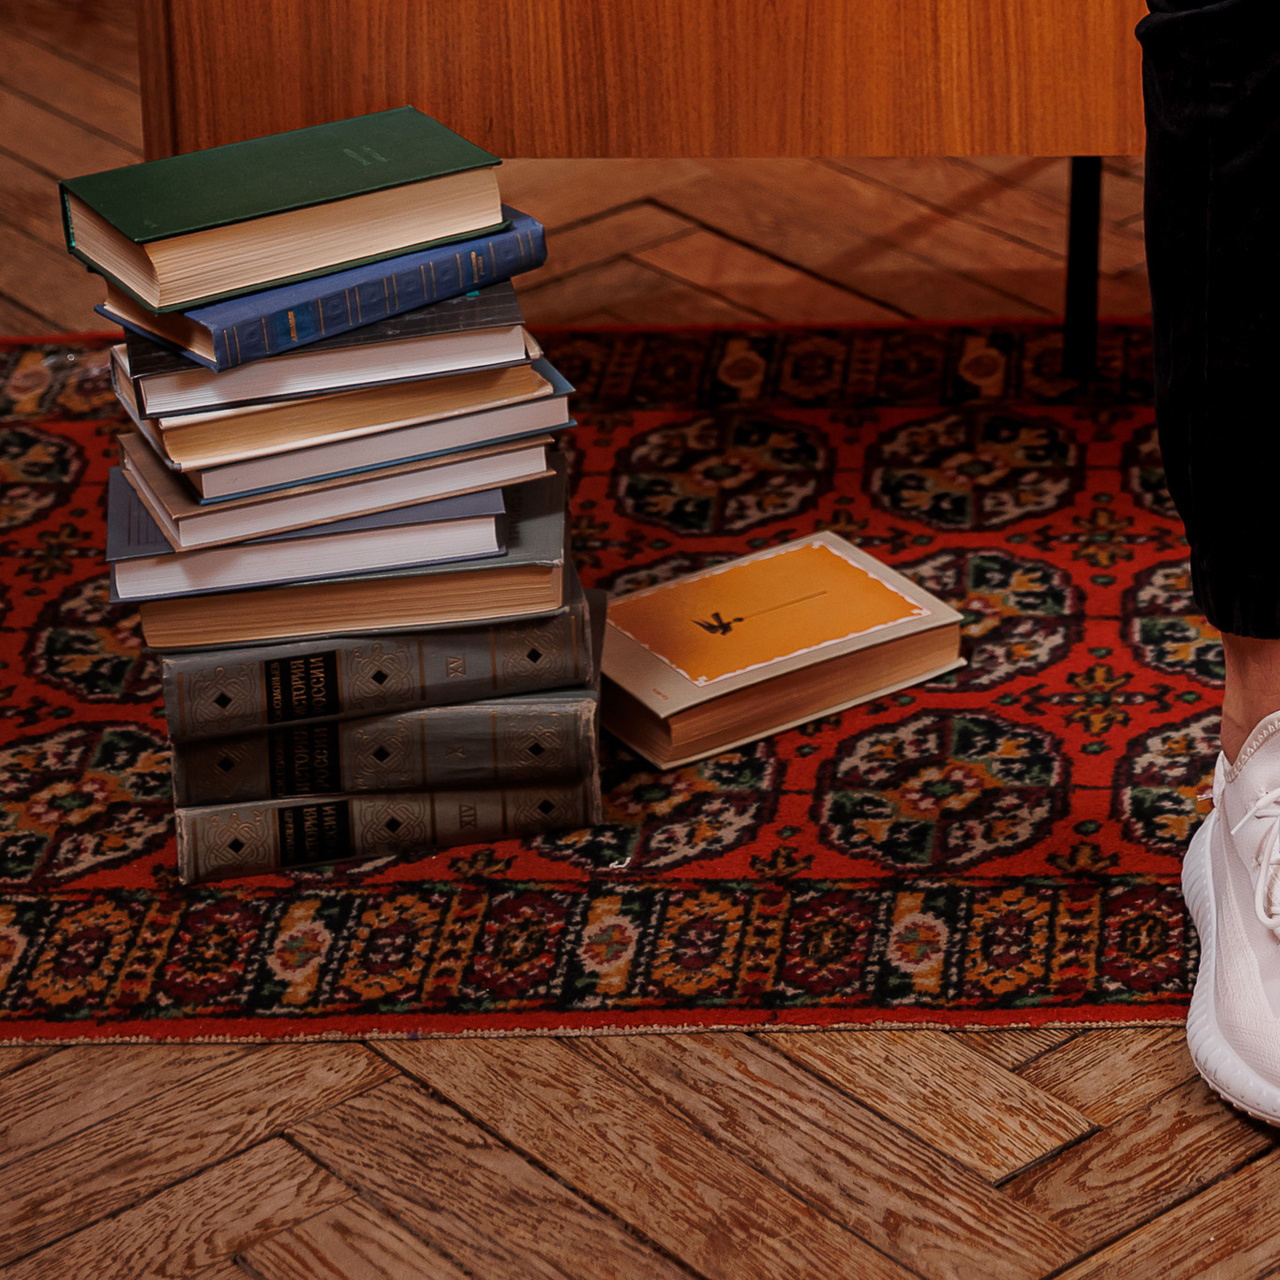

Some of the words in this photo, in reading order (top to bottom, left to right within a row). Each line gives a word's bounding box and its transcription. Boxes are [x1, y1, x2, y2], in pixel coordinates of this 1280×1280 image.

[290, 658, 308, 717] ИСТОРИЯ
[309, 656, 327, 715] РОССИИ
[294, 725, 311, 792] ИСТОРИЯ
[314, 727, 330, 788] РОССИИ
